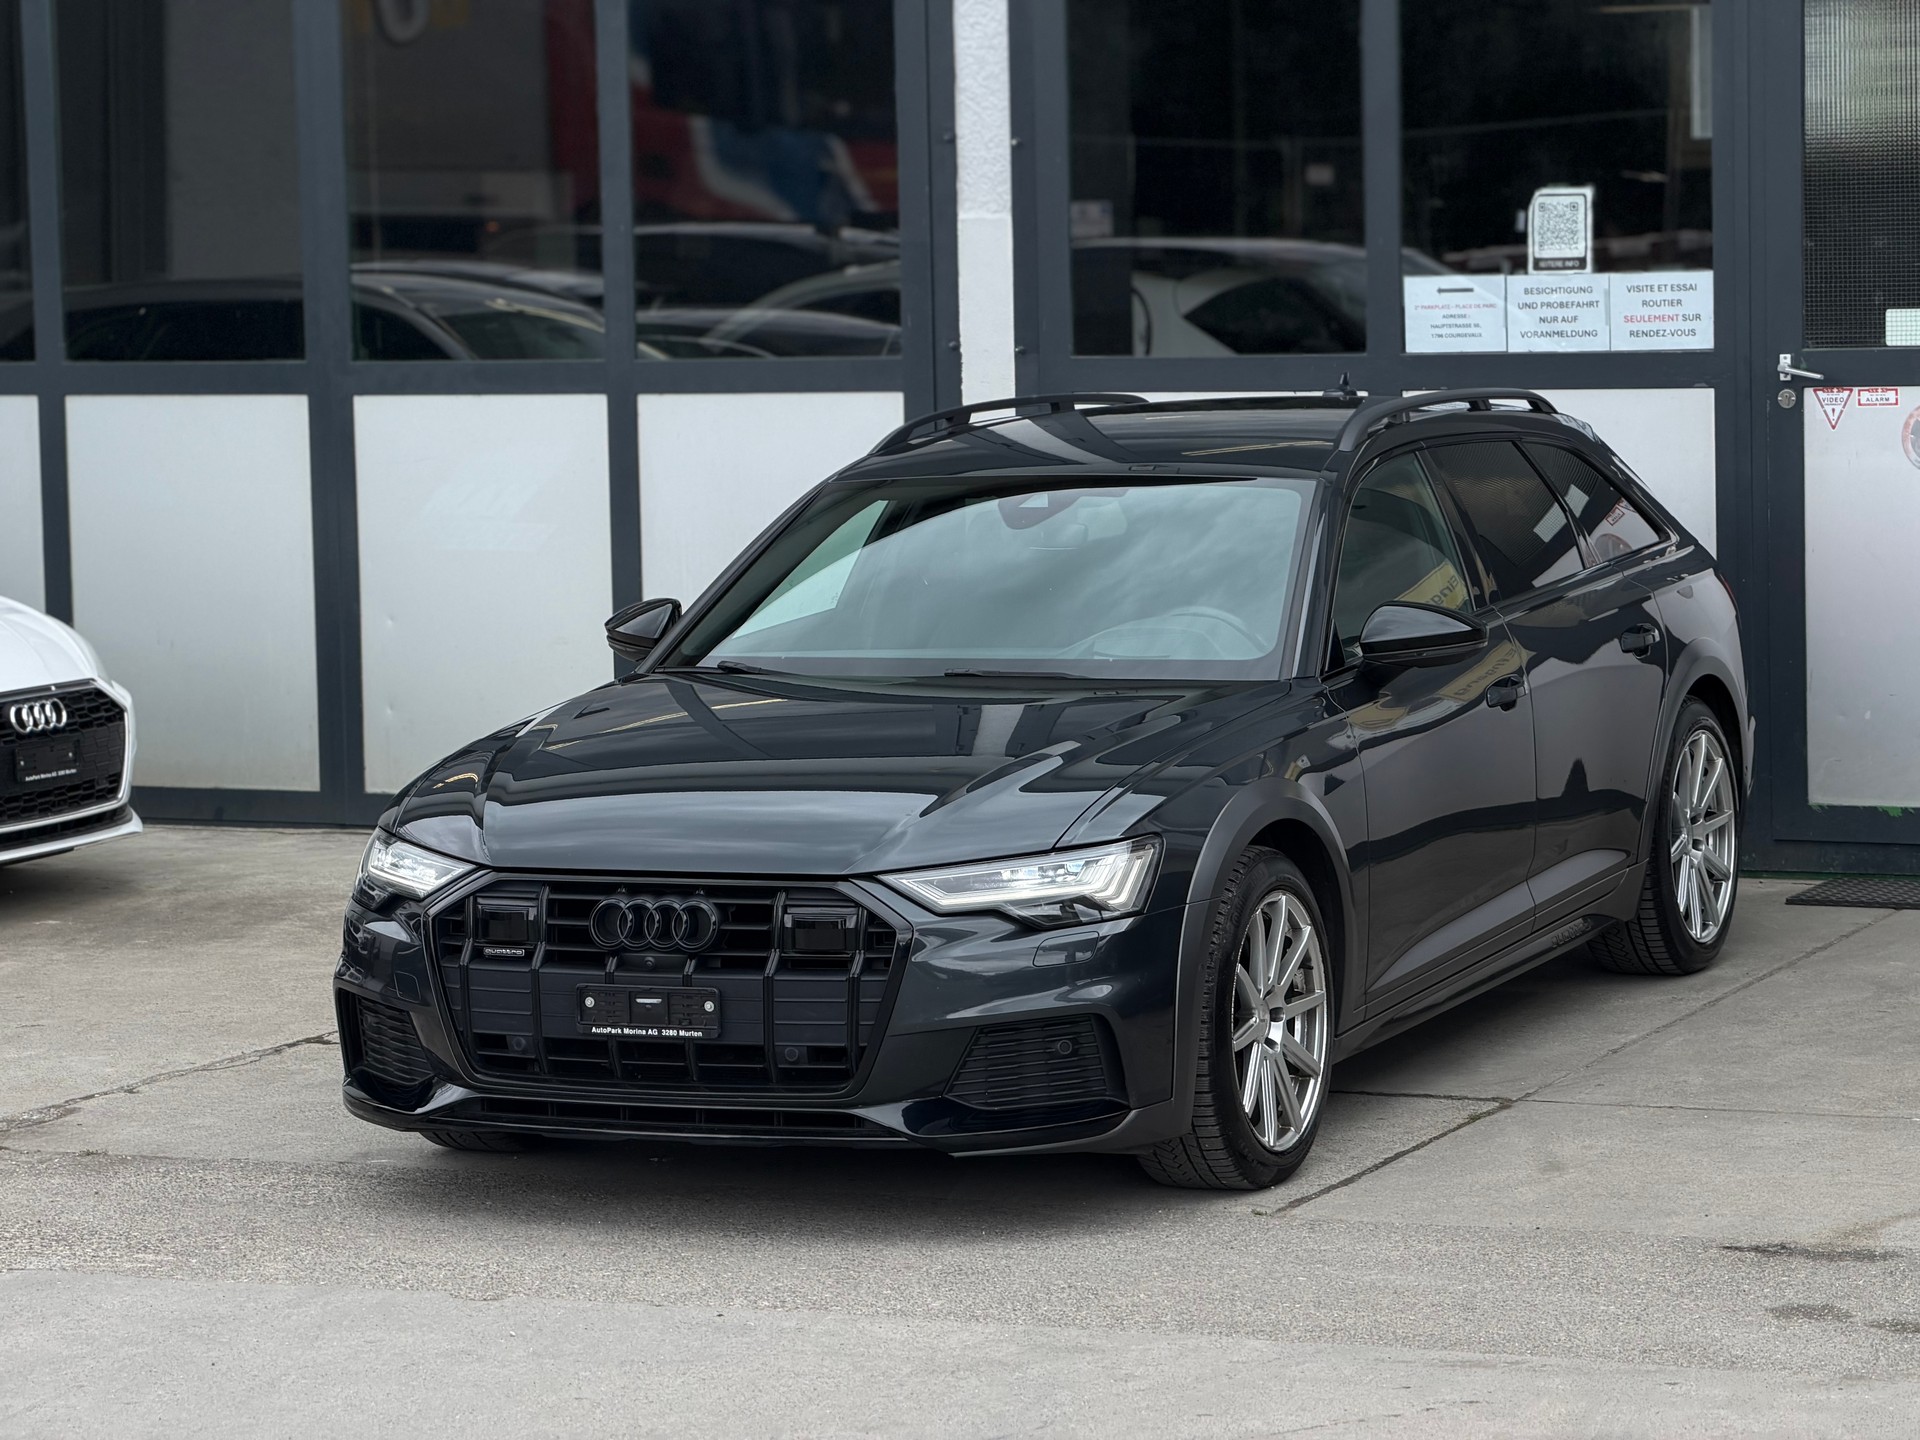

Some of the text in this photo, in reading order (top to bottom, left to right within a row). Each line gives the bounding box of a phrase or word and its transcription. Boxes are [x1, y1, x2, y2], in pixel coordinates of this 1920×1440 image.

[1523, 286, 1593, 295] BESICHTIGUNG
[1626, 284, 1697, 293] VISITE ET ESSAI
[1518, 300, 1600, 310] UND PROBEFAHRT
[1641, 299, 1682, 308] ROUTIER
[1539, 315, 1579, 324] NUR AUF
[1623, 314, 1702, 323] SEULEMENT SUR
[1519, 329, 1598, 339] VORANMELDUNG
[1629, 328, 1697, 338] RENDEZ-VOUS
[484, 948, 523, 956] quattro
[592, 1026, 622, 1034] AutoPark
[648, 1028, 658, 1036] AG
